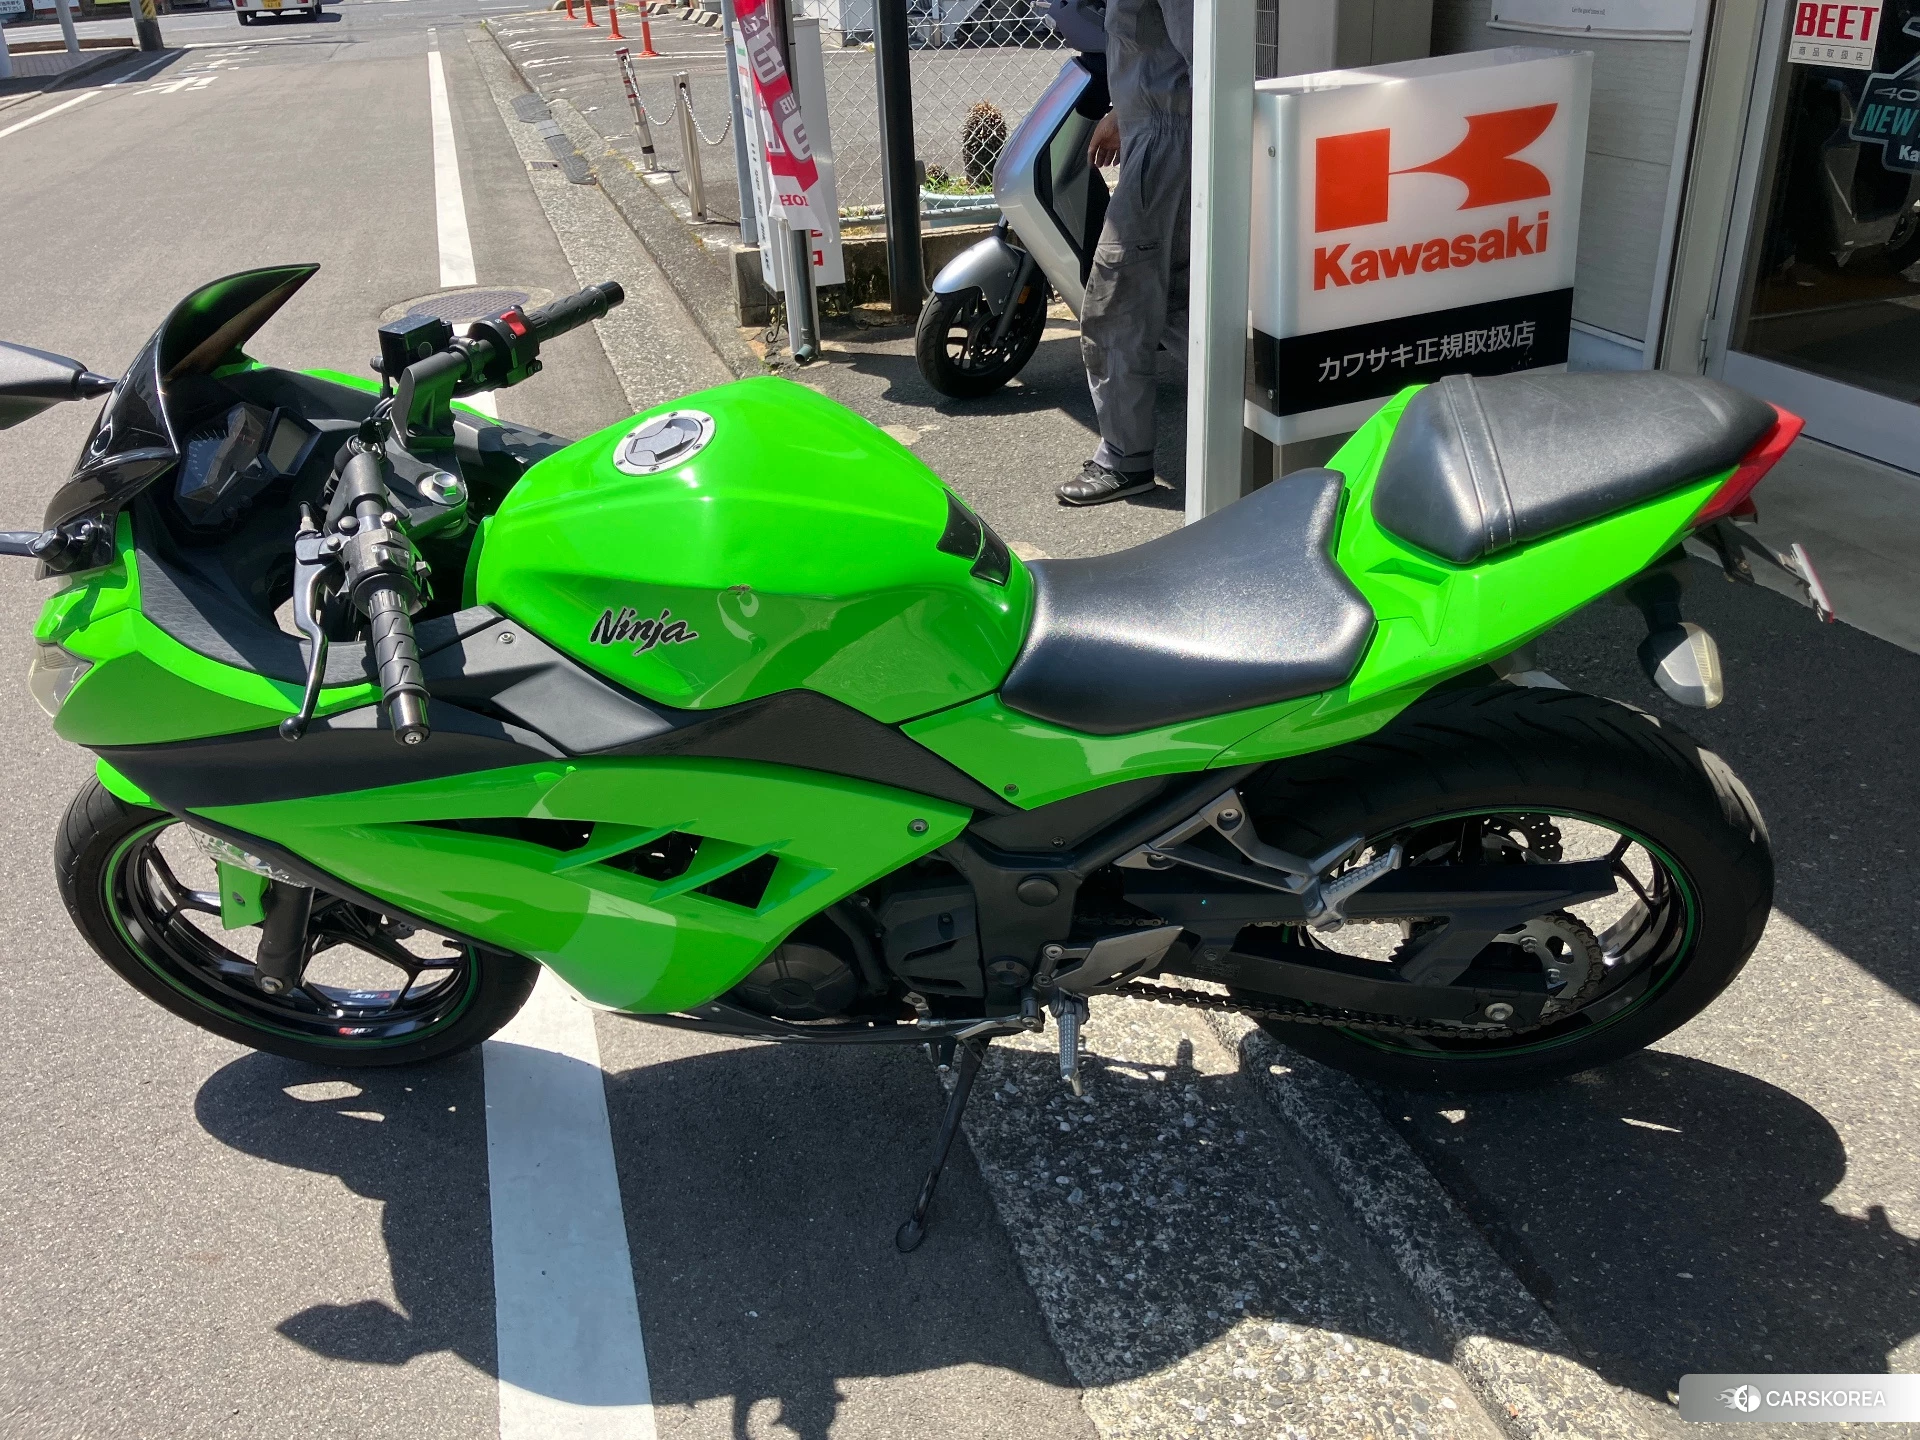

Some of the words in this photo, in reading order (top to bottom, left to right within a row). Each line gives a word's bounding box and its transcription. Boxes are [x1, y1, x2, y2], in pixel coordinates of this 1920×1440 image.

[1795, 3, 1879, 41] BEET
[1859, 103, 1920, 136] NEW
[1313, 210, 1549, 291] Kawasaki
[1317, 320, 1537, 383] カワサキ正規取扱店
[589, 607, 698, 656] Ninja
